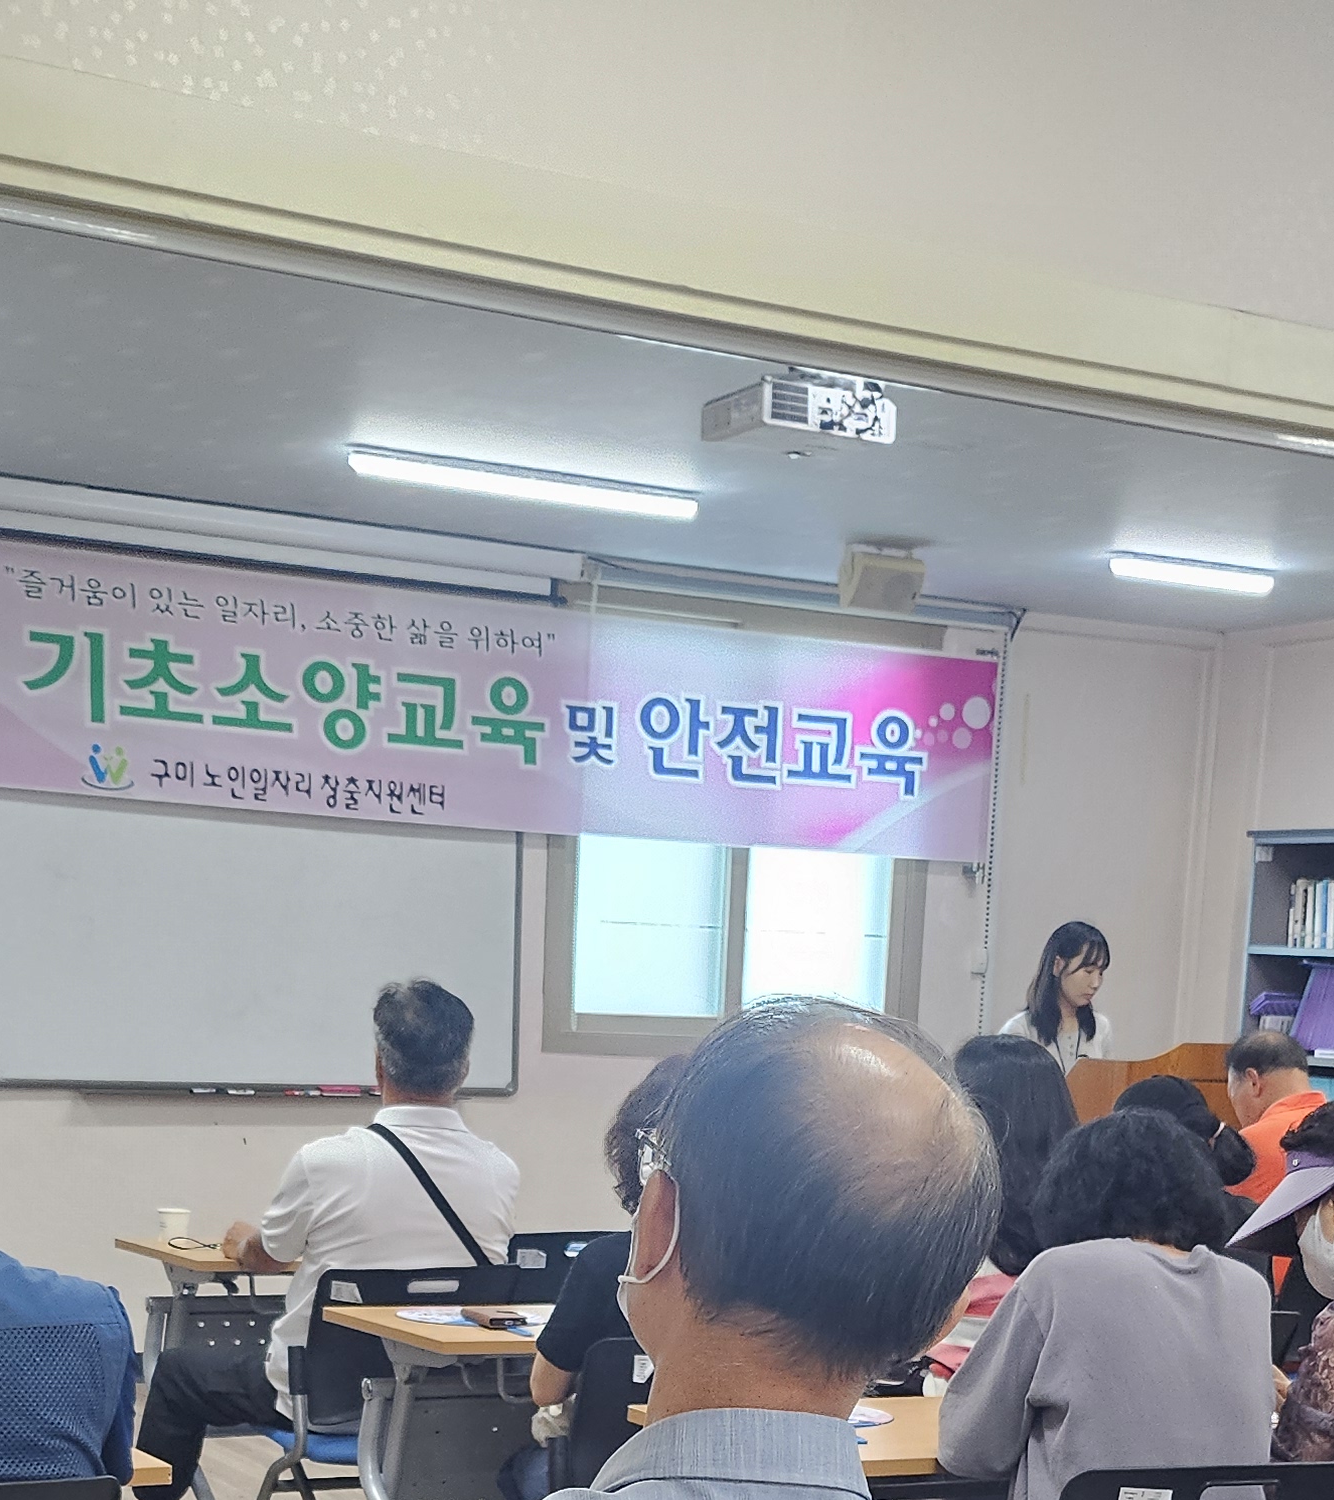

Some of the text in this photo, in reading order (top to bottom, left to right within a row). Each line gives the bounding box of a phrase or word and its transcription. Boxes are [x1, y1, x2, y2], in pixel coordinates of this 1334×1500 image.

[148, 586, 205, 620] 있는
[215, 595, 307, 631] 일자리,
[316, 610, 397, 642] 소중한
[406, 618, 458, 650] 삶을
[22, 629, 546, 766] 기초소양교육
[565, 703, 615, 765] 및
[639, 696, 924, 798] 안전교육
[150, 758, 447, 815] 구미 노인일자리 창출지원센터
